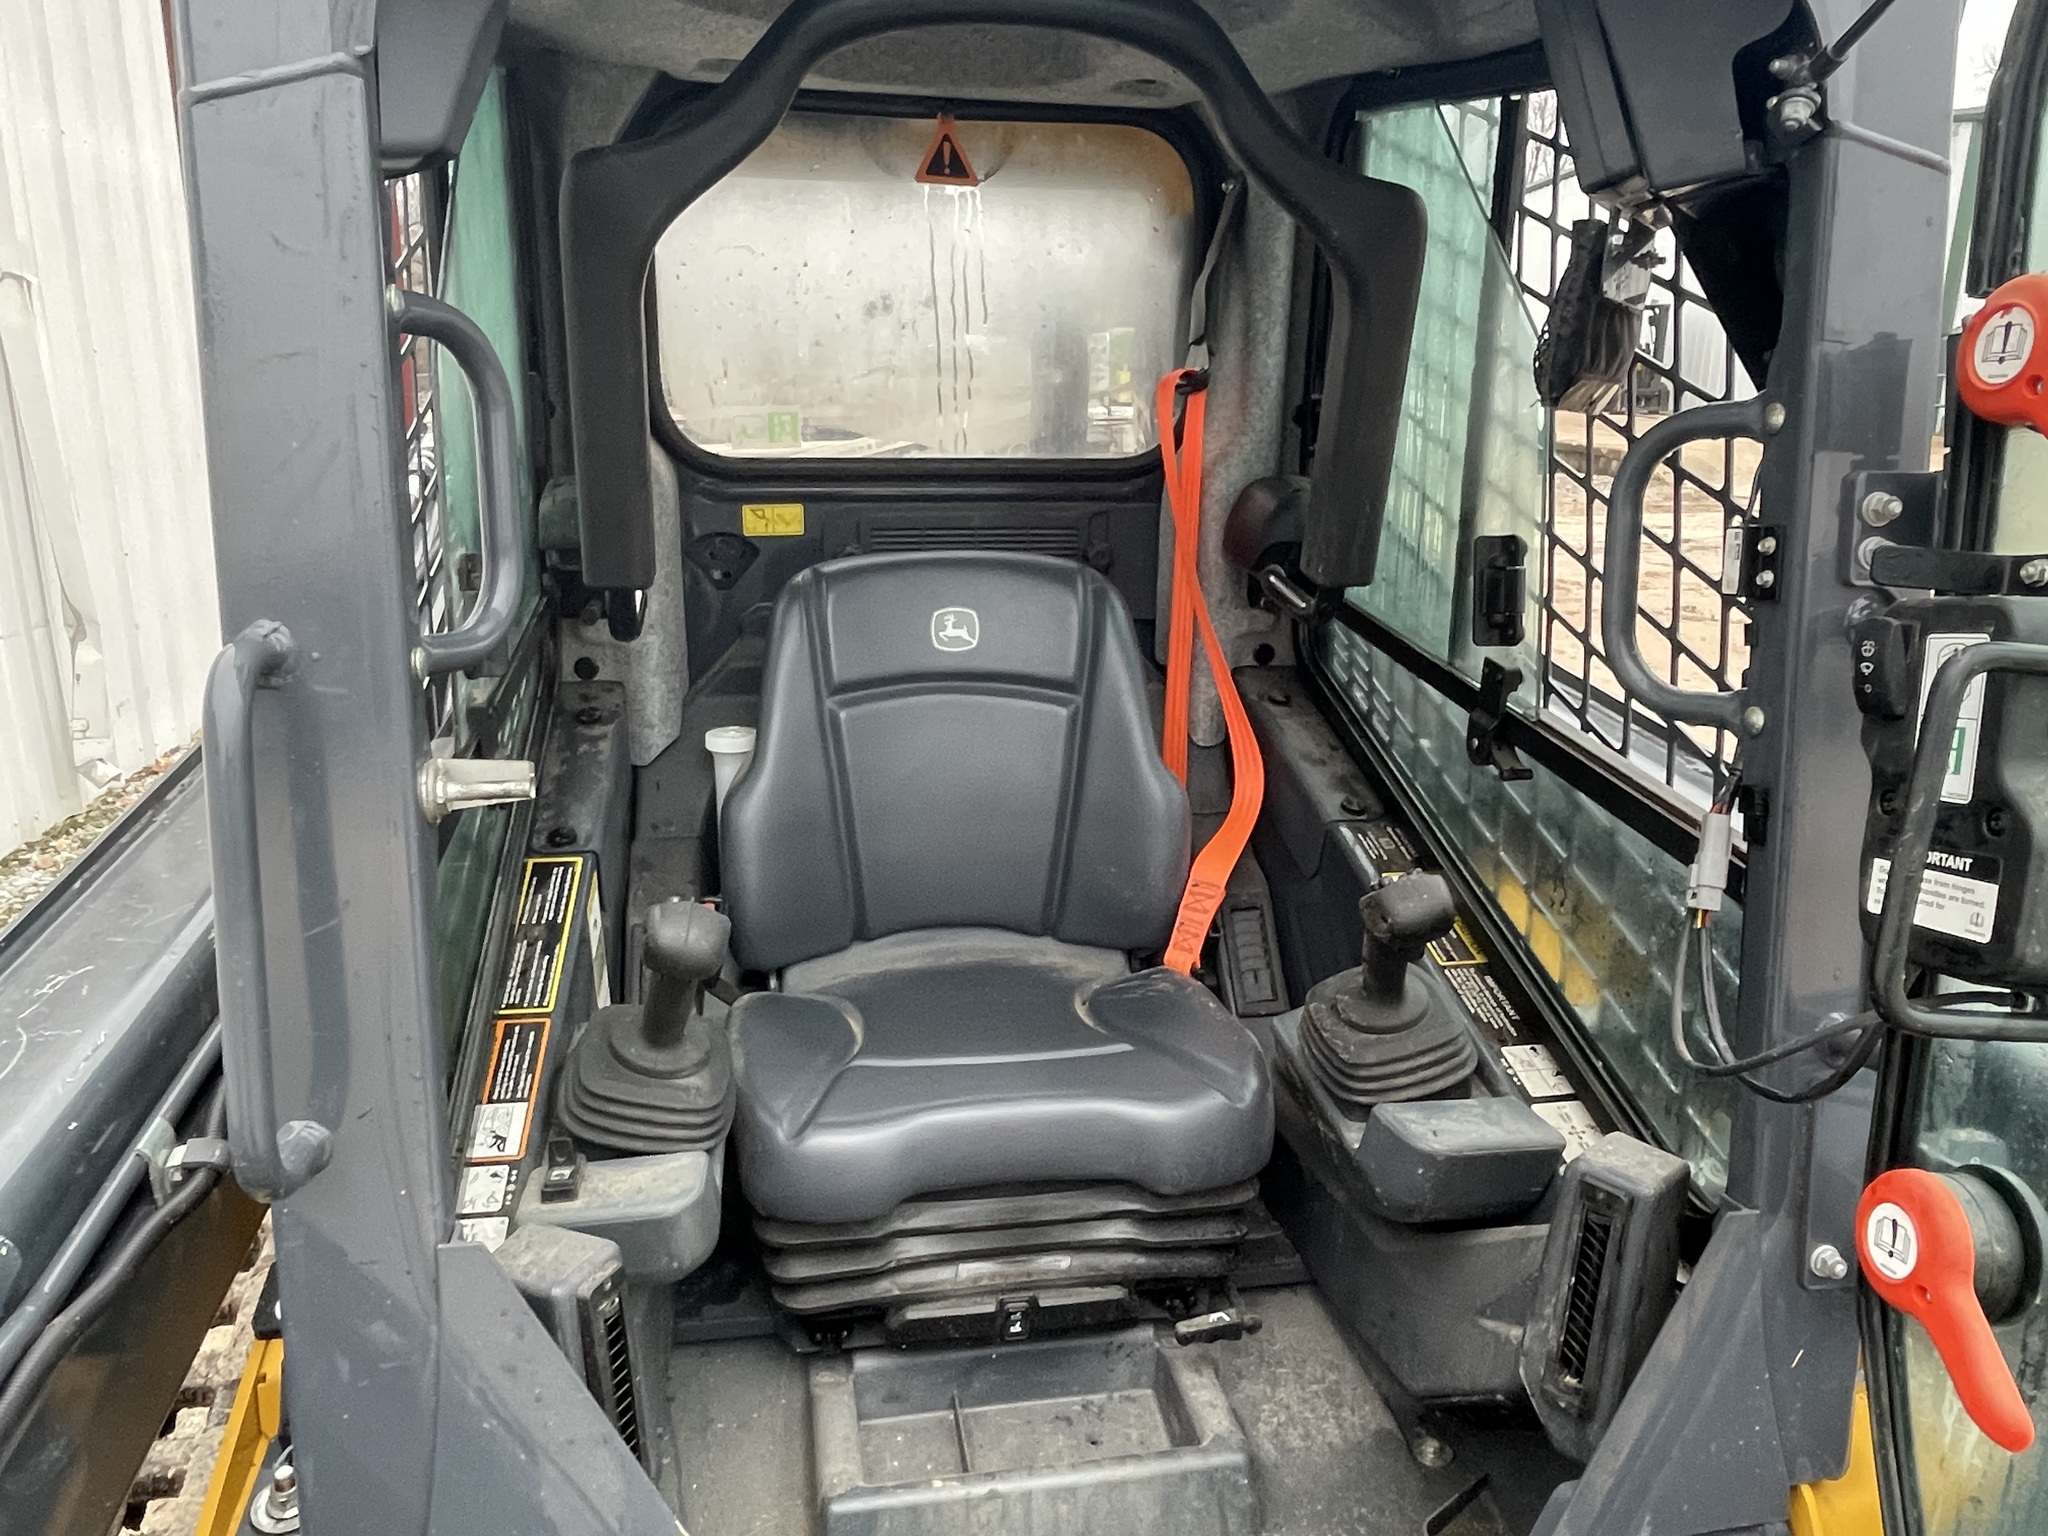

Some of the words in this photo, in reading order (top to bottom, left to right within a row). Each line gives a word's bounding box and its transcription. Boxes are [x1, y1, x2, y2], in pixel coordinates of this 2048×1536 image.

[1926, 850, 1973, 872] ORTANT
[1933, 878, 1950, 888] from
[1484, 975, 1520, 1020] IMPORTANT
